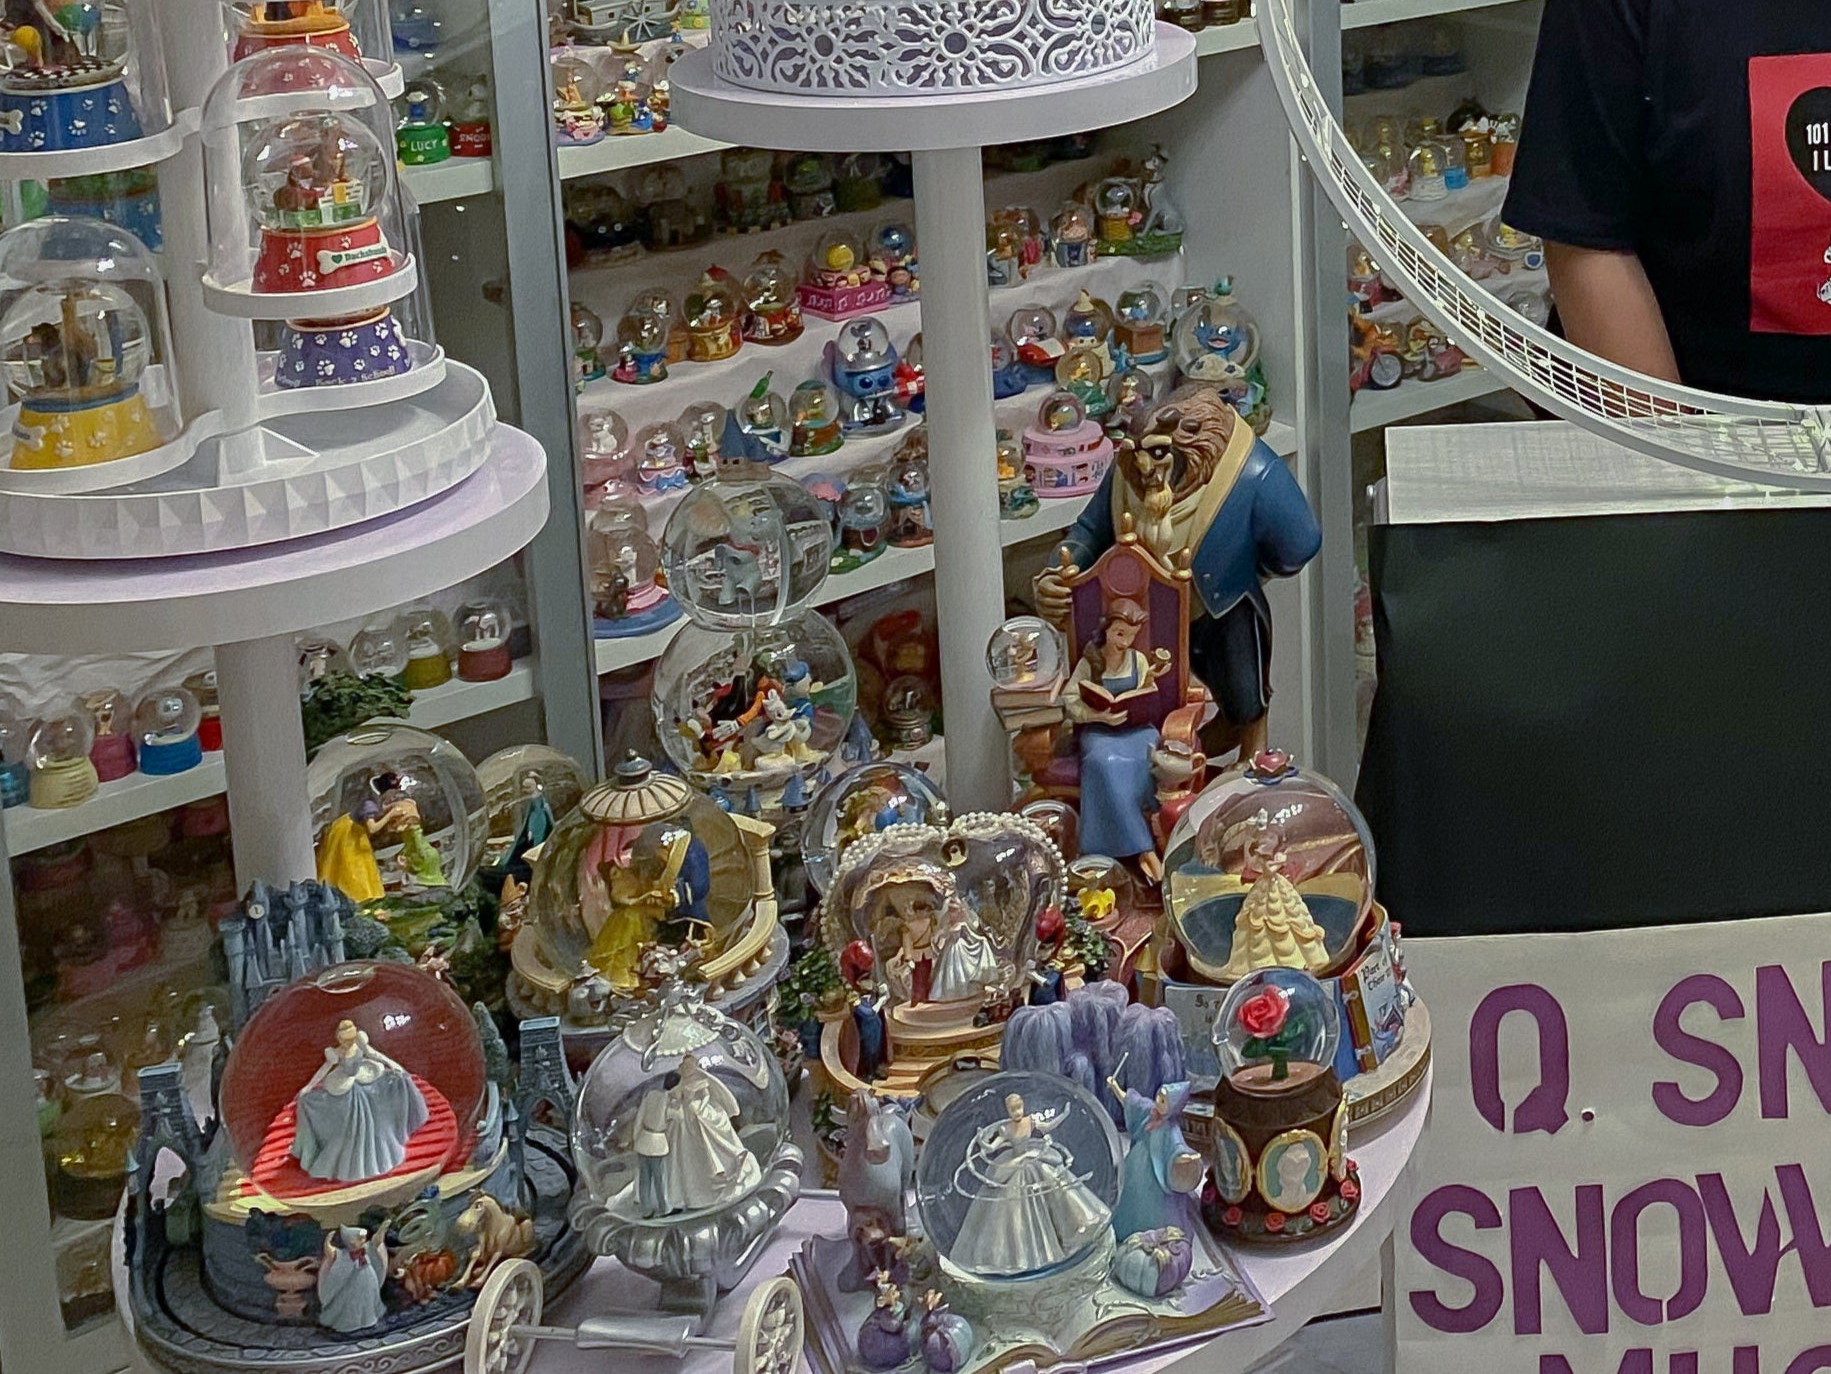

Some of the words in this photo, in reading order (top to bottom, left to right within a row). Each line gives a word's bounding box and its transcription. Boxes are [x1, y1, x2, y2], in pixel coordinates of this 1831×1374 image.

[1806, 122, 1829, 145] 101
[411, 139, 437, 152] LUCY
[1813, 150, 1819, 171] I
